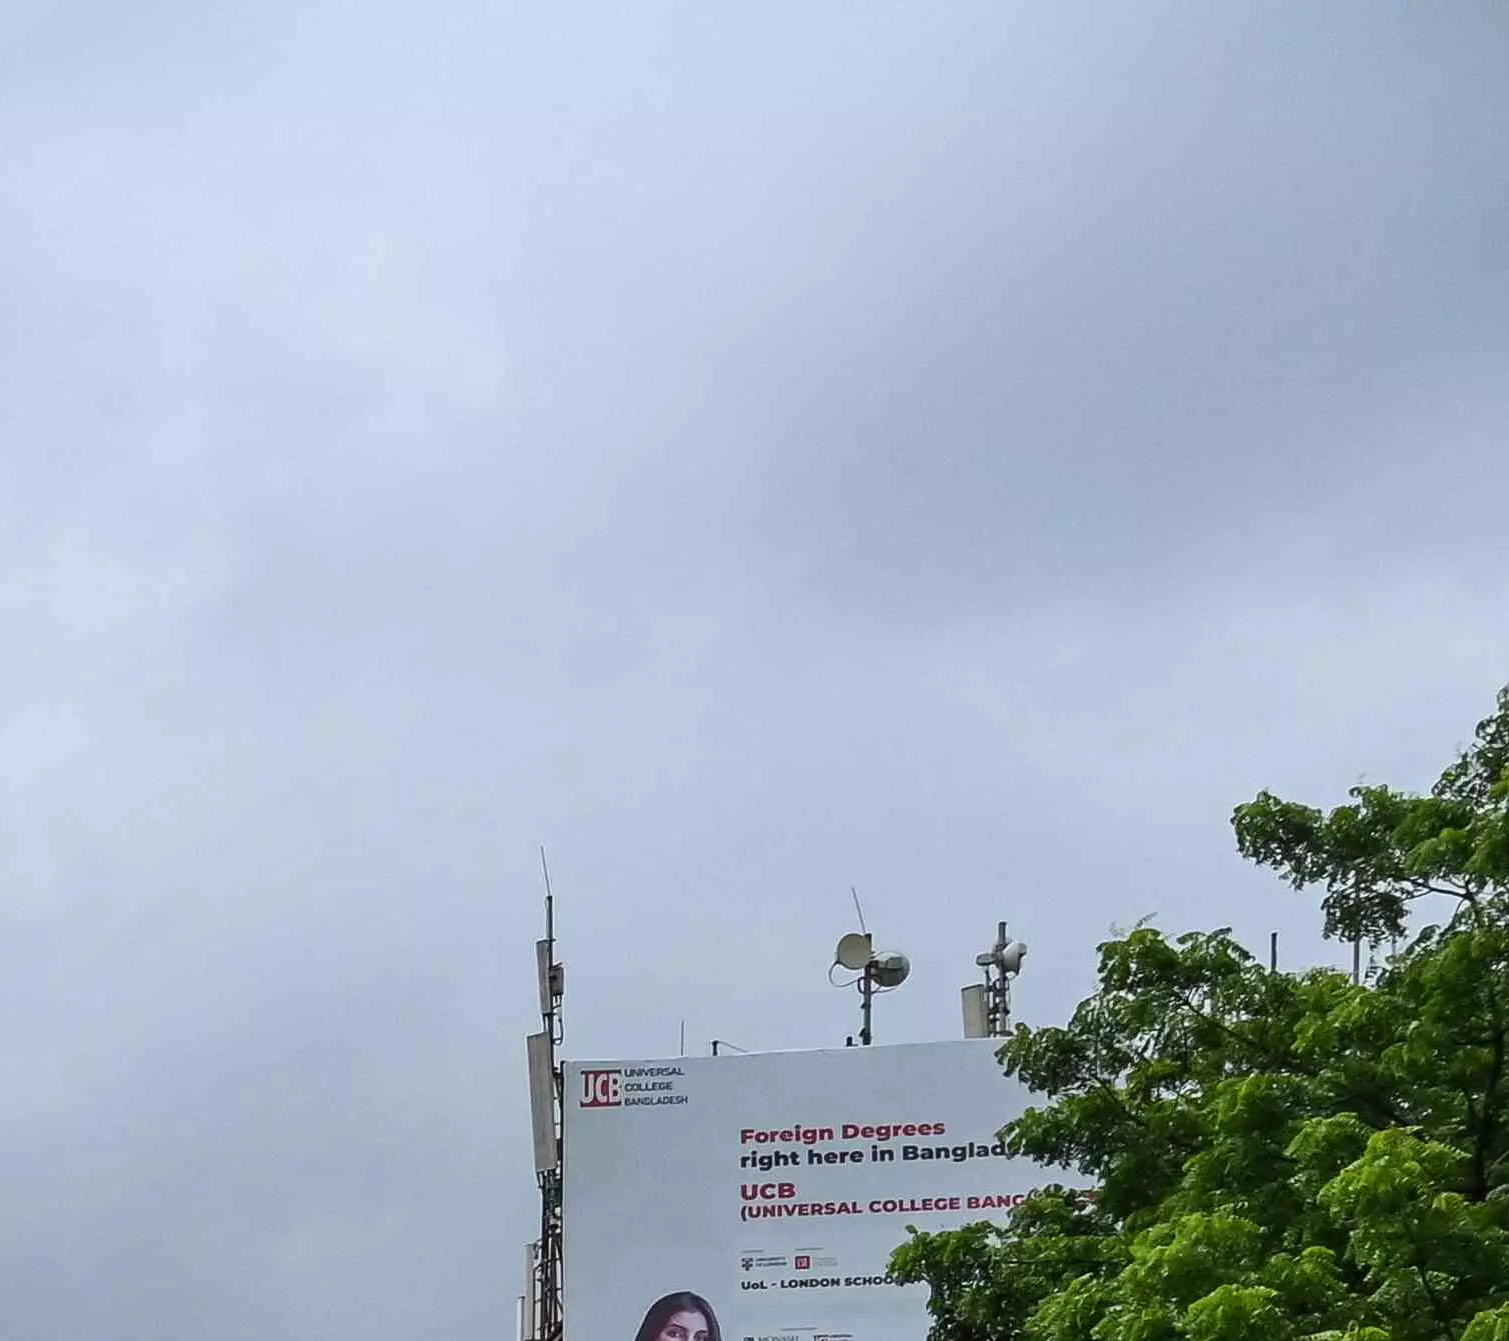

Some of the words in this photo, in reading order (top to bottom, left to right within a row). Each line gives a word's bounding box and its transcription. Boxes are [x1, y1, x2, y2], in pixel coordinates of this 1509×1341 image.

[623, 1066, 685, 1078] UNIVERSAL
[624, 1081, 674, 1092] COLLEGE
[624, 1095, 689, 1106] BANGLADESH
[740, 1124, 835, 1147] Foreign
[842, 1121, 946, 1142] Degrees
[740, 1150, 801, 1172] right
[807, 1148, 864, 1166] here
[871, 1145, 895, 1162] in
[740, 1182, 796, 1200] UCB
[740, 1200, 863, 1222] (UNIVERSAL
[868, 1197, 962, 1214] COLLEGE
[780, 1277, 841, 1290] LONDON
